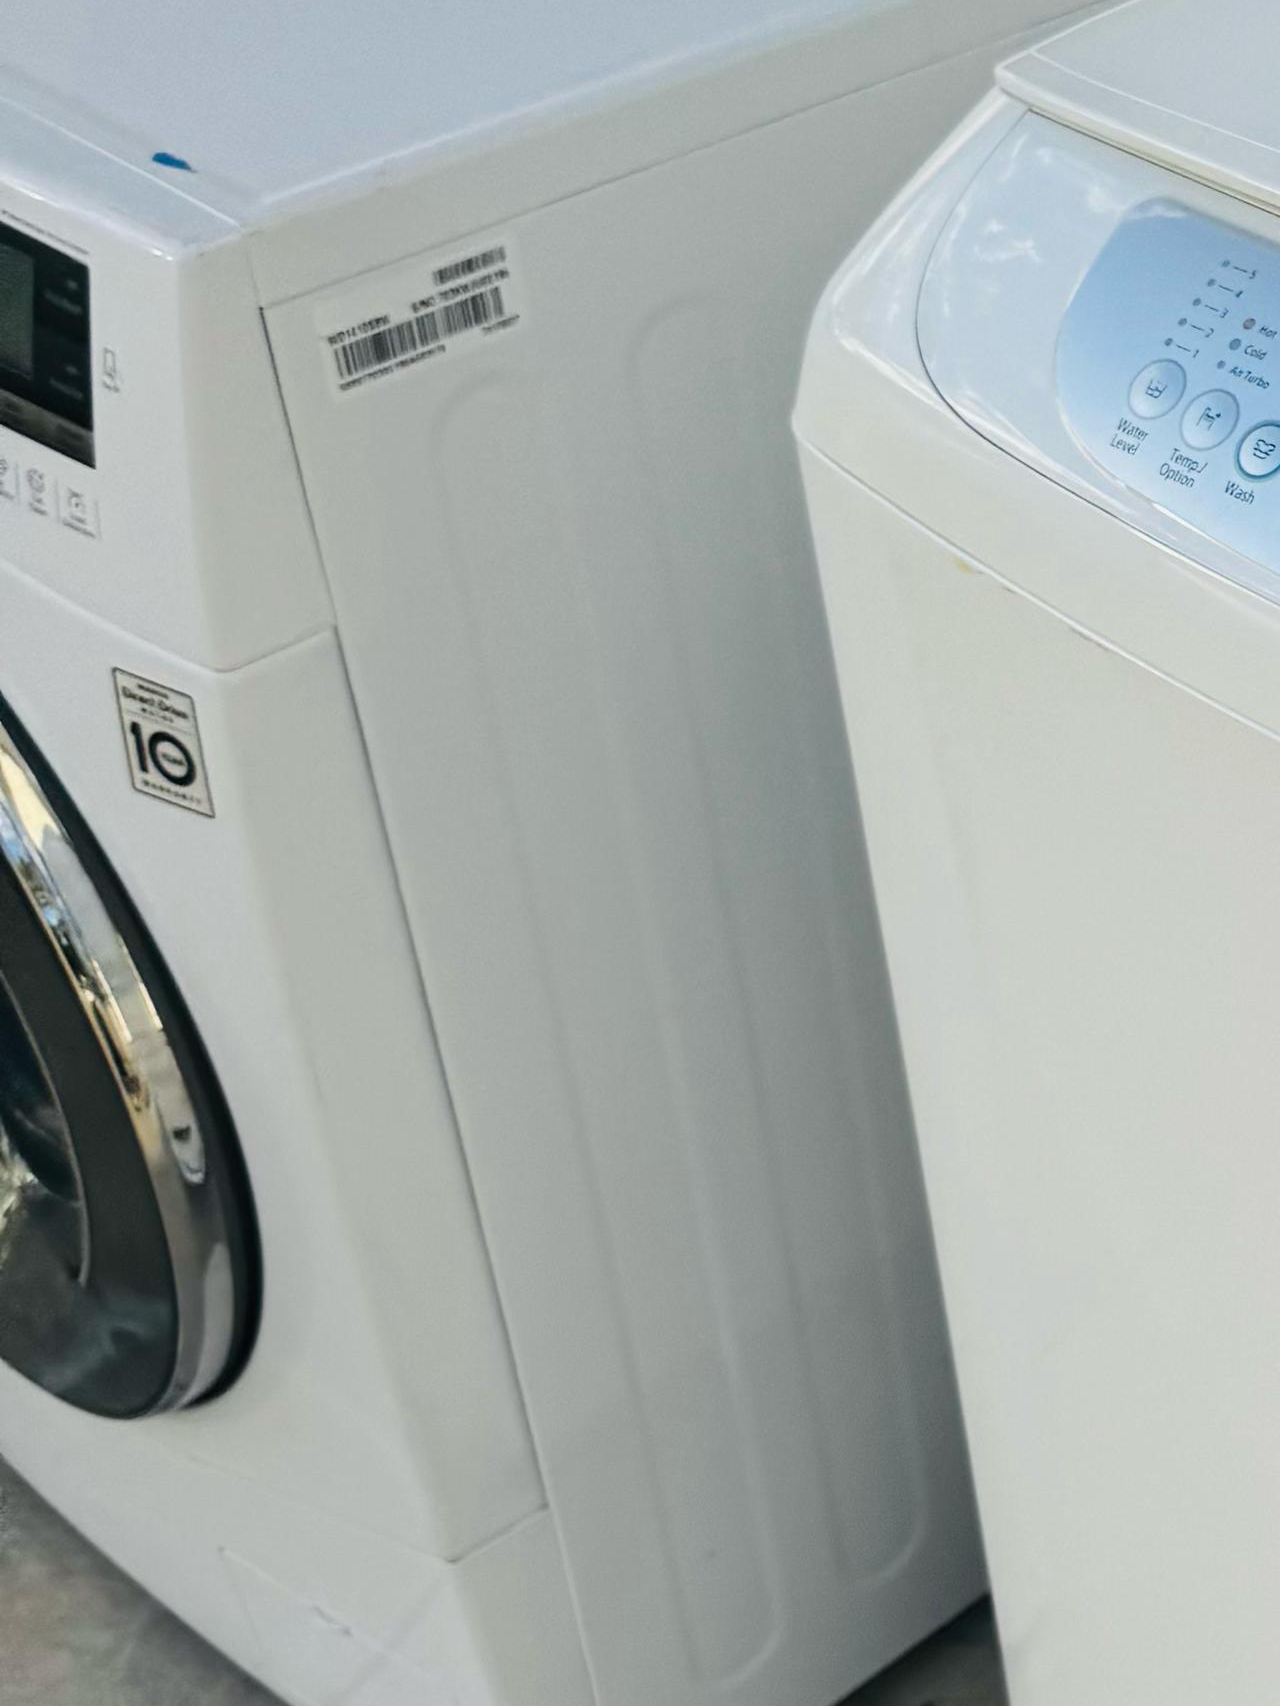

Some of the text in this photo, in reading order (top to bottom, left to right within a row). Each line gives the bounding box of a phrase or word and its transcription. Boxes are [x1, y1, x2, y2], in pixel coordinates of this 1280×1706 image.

[1259, 326, 1278, 339] Hot
[1244, 345, 1268, 360] Cold
[1244, 370, 1270, 389] Turbo
[1117, 417, 1150, 442] Water
[1110, 434, 1139, 455] Level
[1159, 463, 1195, 488] Option
[1223, 481, 1256, 505] Wash
